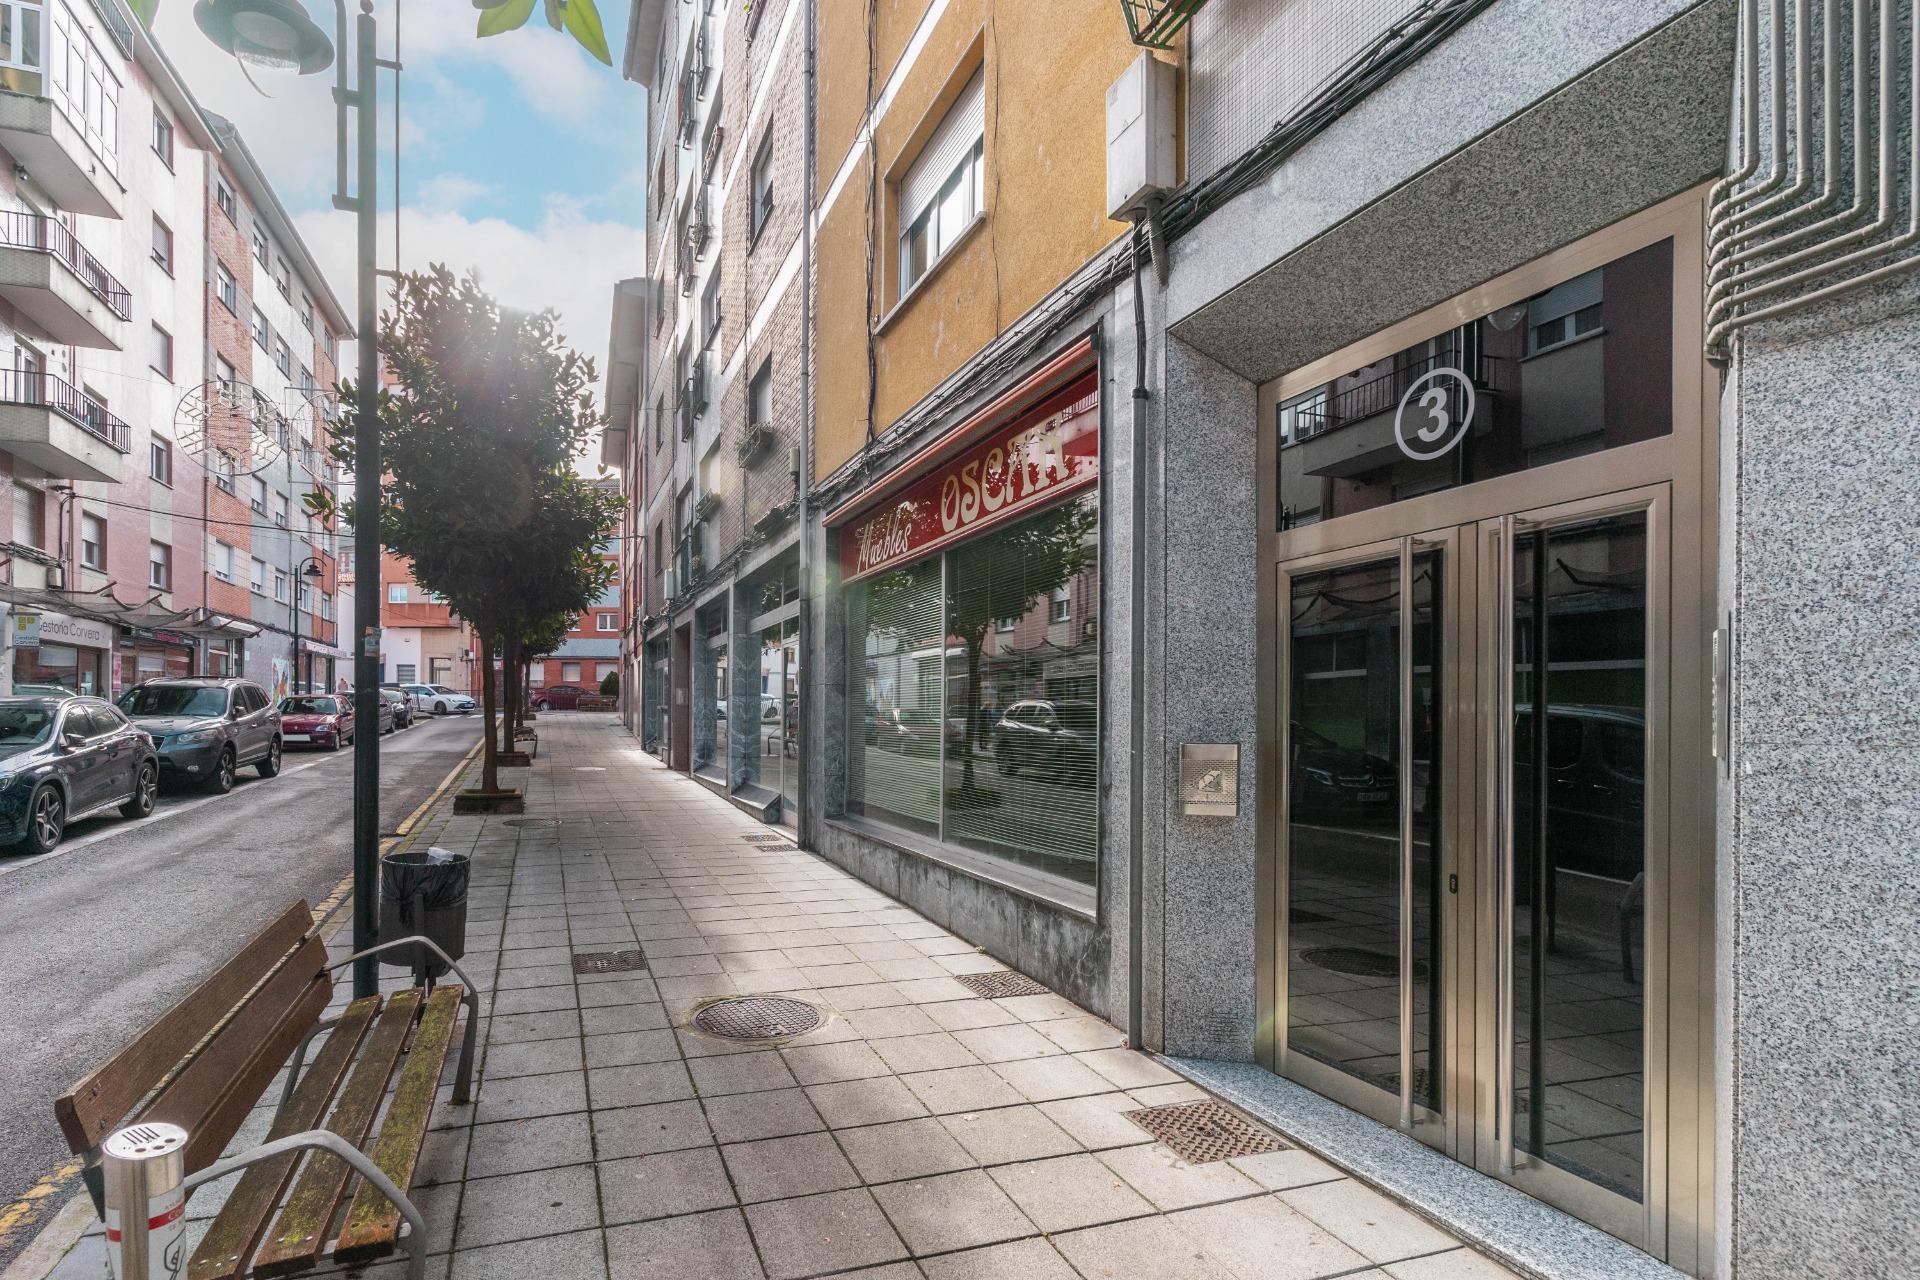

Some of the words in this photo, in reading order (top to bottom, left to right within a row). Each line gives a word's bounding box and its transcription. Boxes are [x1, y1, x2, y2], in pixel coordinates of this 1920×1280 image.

[1418, 387, 1449, 442] 3
[856, 511, 912, 574] Muebles
[941, 410, 1070, 532] OSCAR
[39, 619, 69, 636] estoría
[70, 622, 100, 640] Corvera
